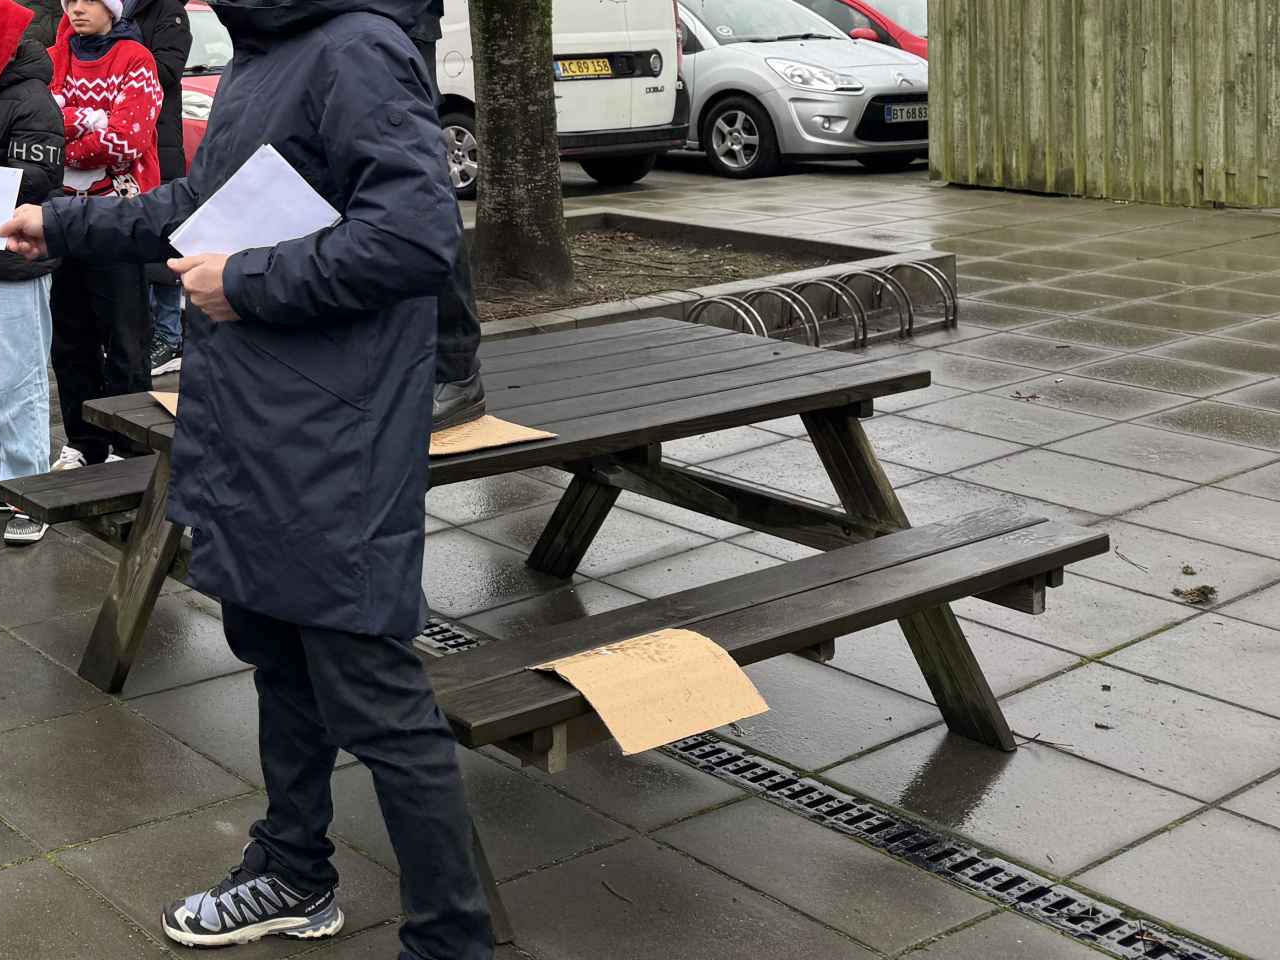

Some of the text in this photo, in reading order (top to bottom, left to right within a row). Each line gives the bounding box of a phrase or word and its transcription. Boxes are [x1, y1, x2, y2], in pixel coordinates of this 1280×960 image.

[561, 60, 609, 74] AC 89 158
[892, 107, 904, 120] BT
[918, 106, 928, 119] 83
[7, 140, 62, 165] HST
